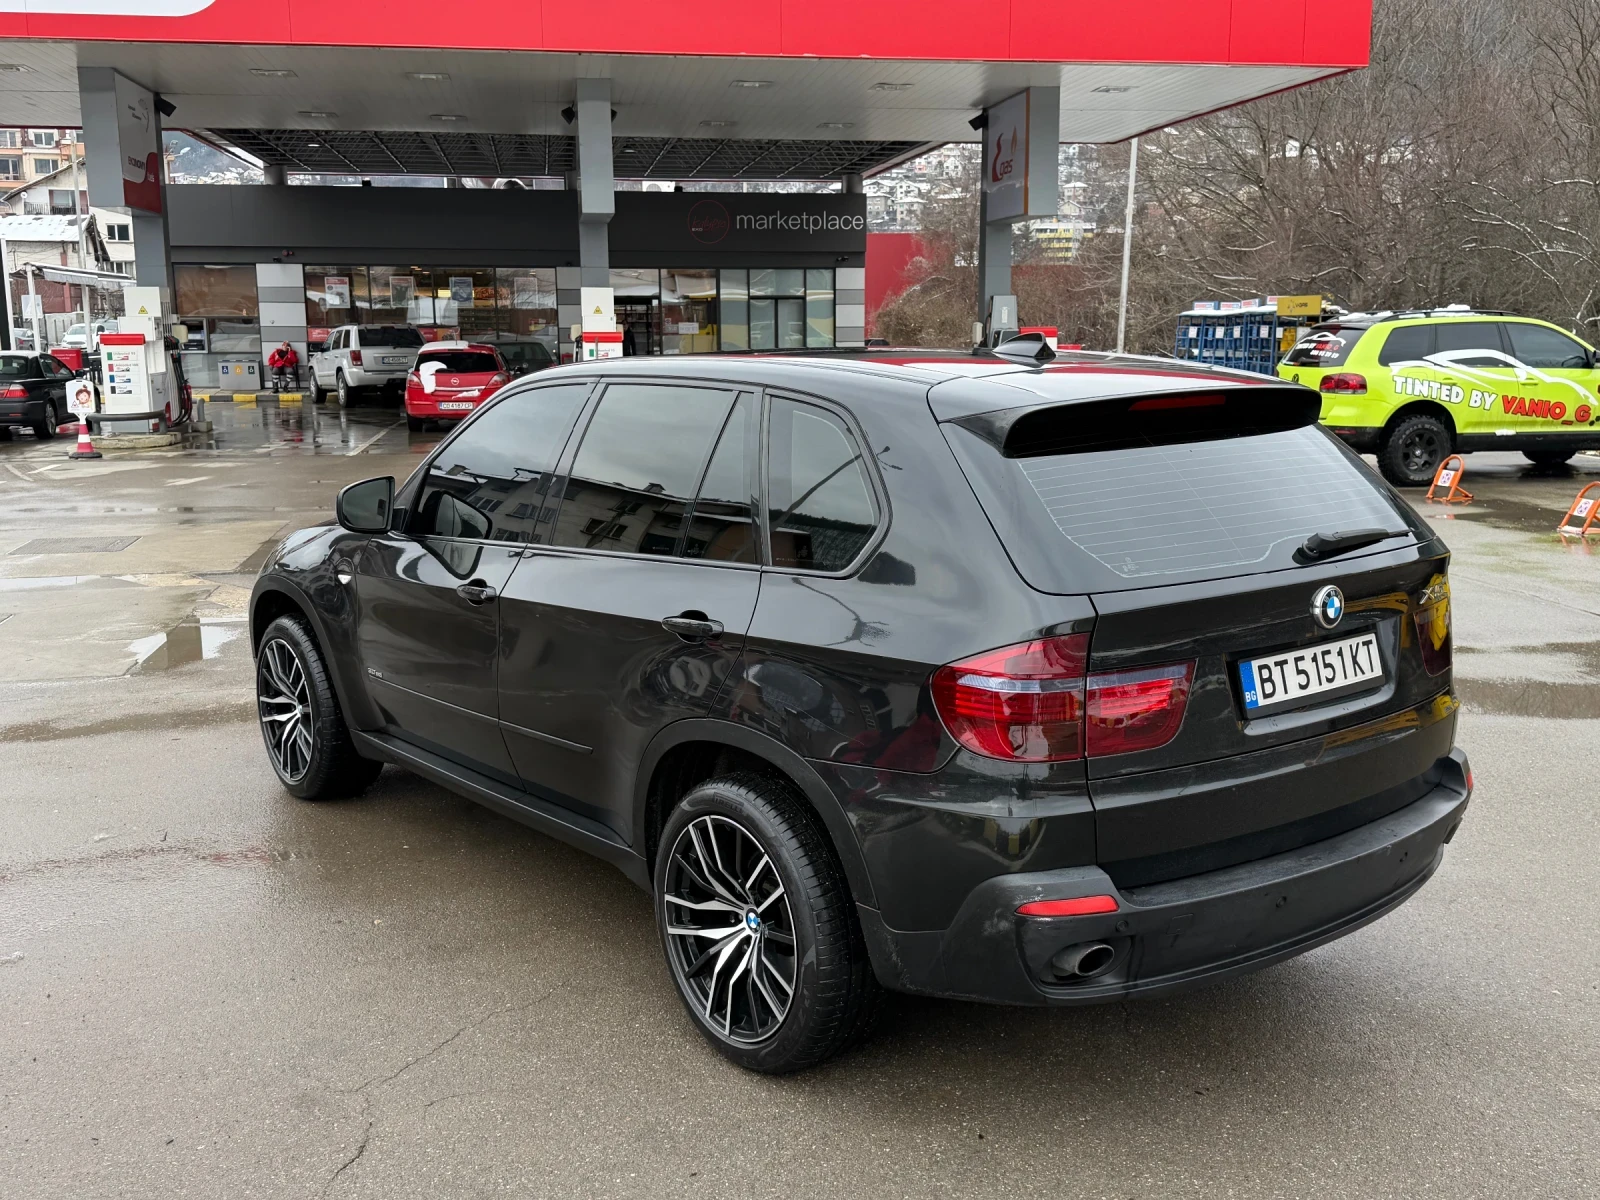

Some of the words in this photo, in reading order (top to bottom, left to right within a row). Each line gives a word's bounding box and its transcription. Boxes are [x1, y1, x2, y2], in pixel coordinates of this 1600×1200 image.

[736, 210, 864, 235] marketplace
[1393, 376, 1464, 404] TINTED
[1468, 389, 1498, 411] BY
[1245, 691, 1257, 703] BG
